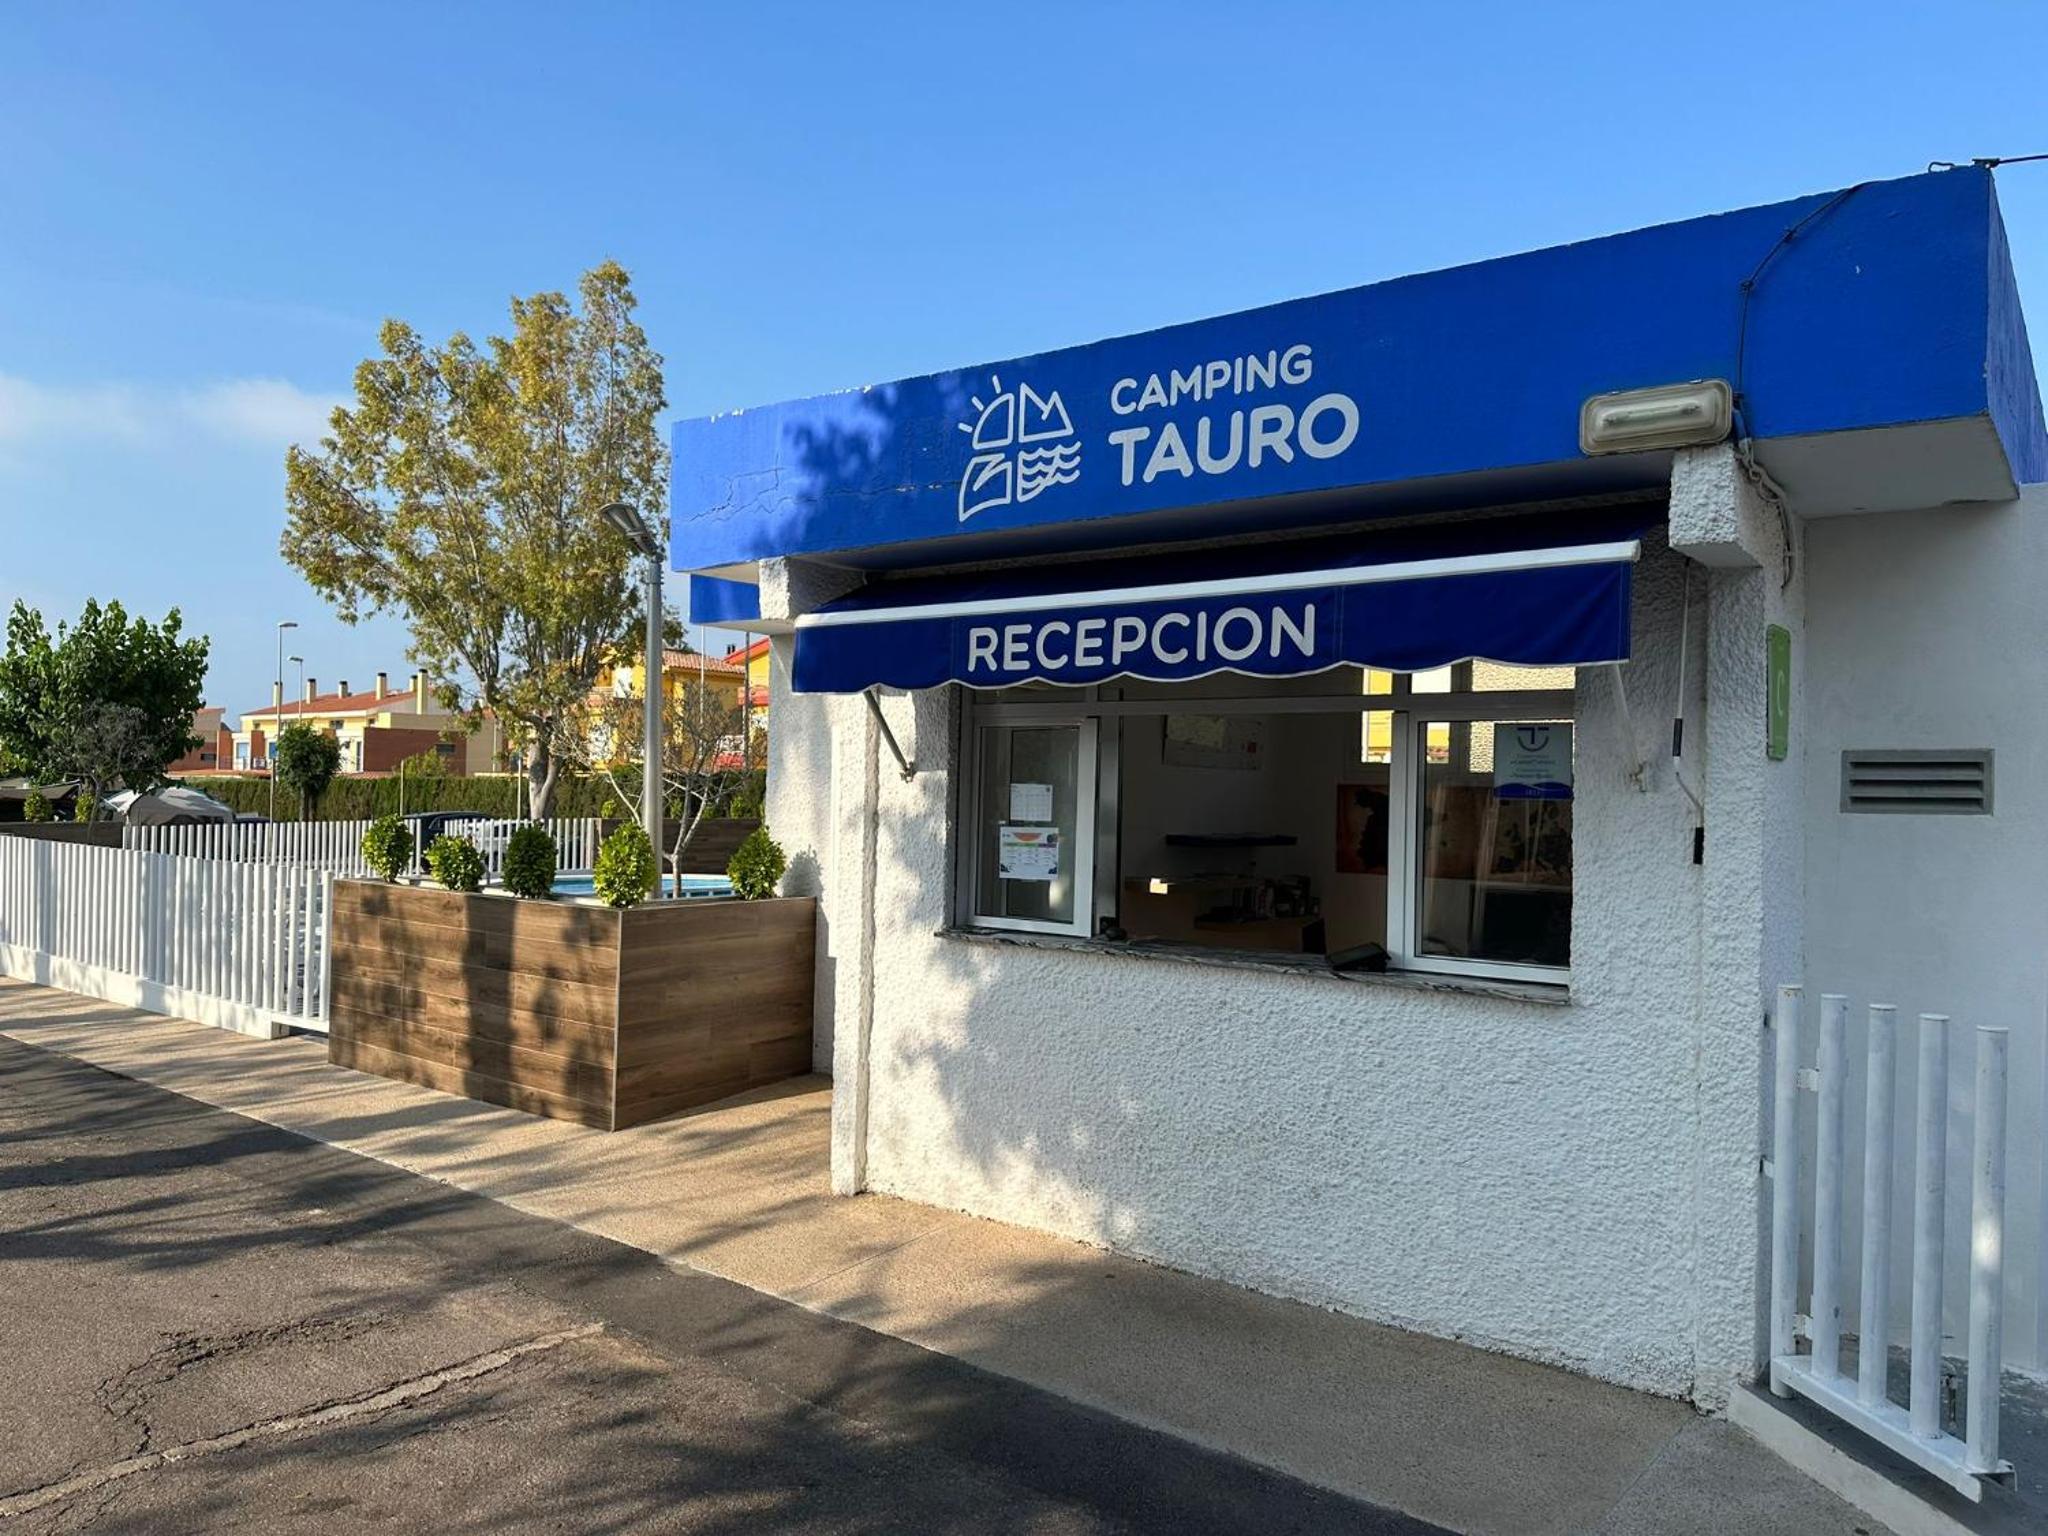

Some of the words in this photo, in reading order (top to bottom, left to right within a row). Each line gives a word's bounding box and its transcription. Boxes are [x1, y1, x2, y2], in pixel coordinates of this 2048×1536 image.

[1111, 344, 1313, 415] CAMPING
[1108, 392, 1360, 487] TAURO
[967, 603, 1316, 673] RECEPCION
